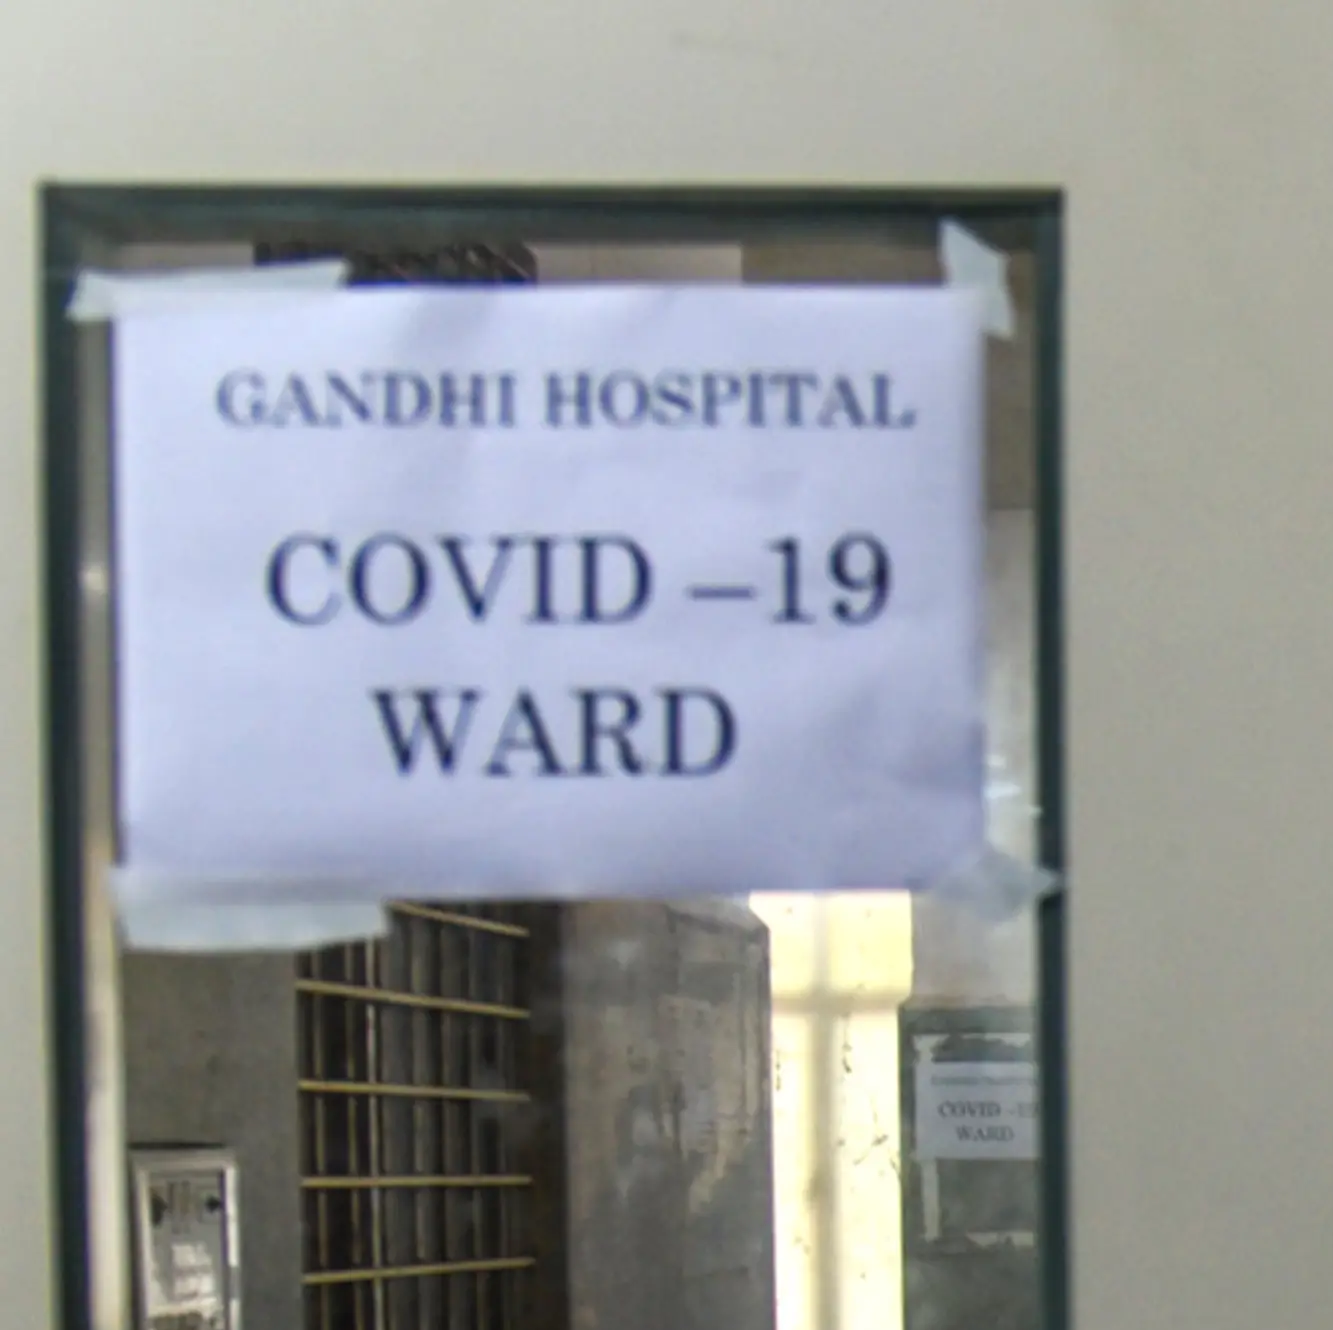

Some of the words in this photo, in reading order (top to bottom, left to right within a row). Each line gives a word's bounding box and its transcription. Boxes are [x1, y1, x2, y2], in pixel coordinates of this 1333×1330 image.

[216, 370, 518, 429] GANDHI
[546, 370, 917, 430] HOSPITAL
[266, 534, 653, 627] COVID
[370, 689, 741, 778] WARD
[938, 1101, 1001, 1118] COVID
[956, 1126, 1015, 1142] WARD
